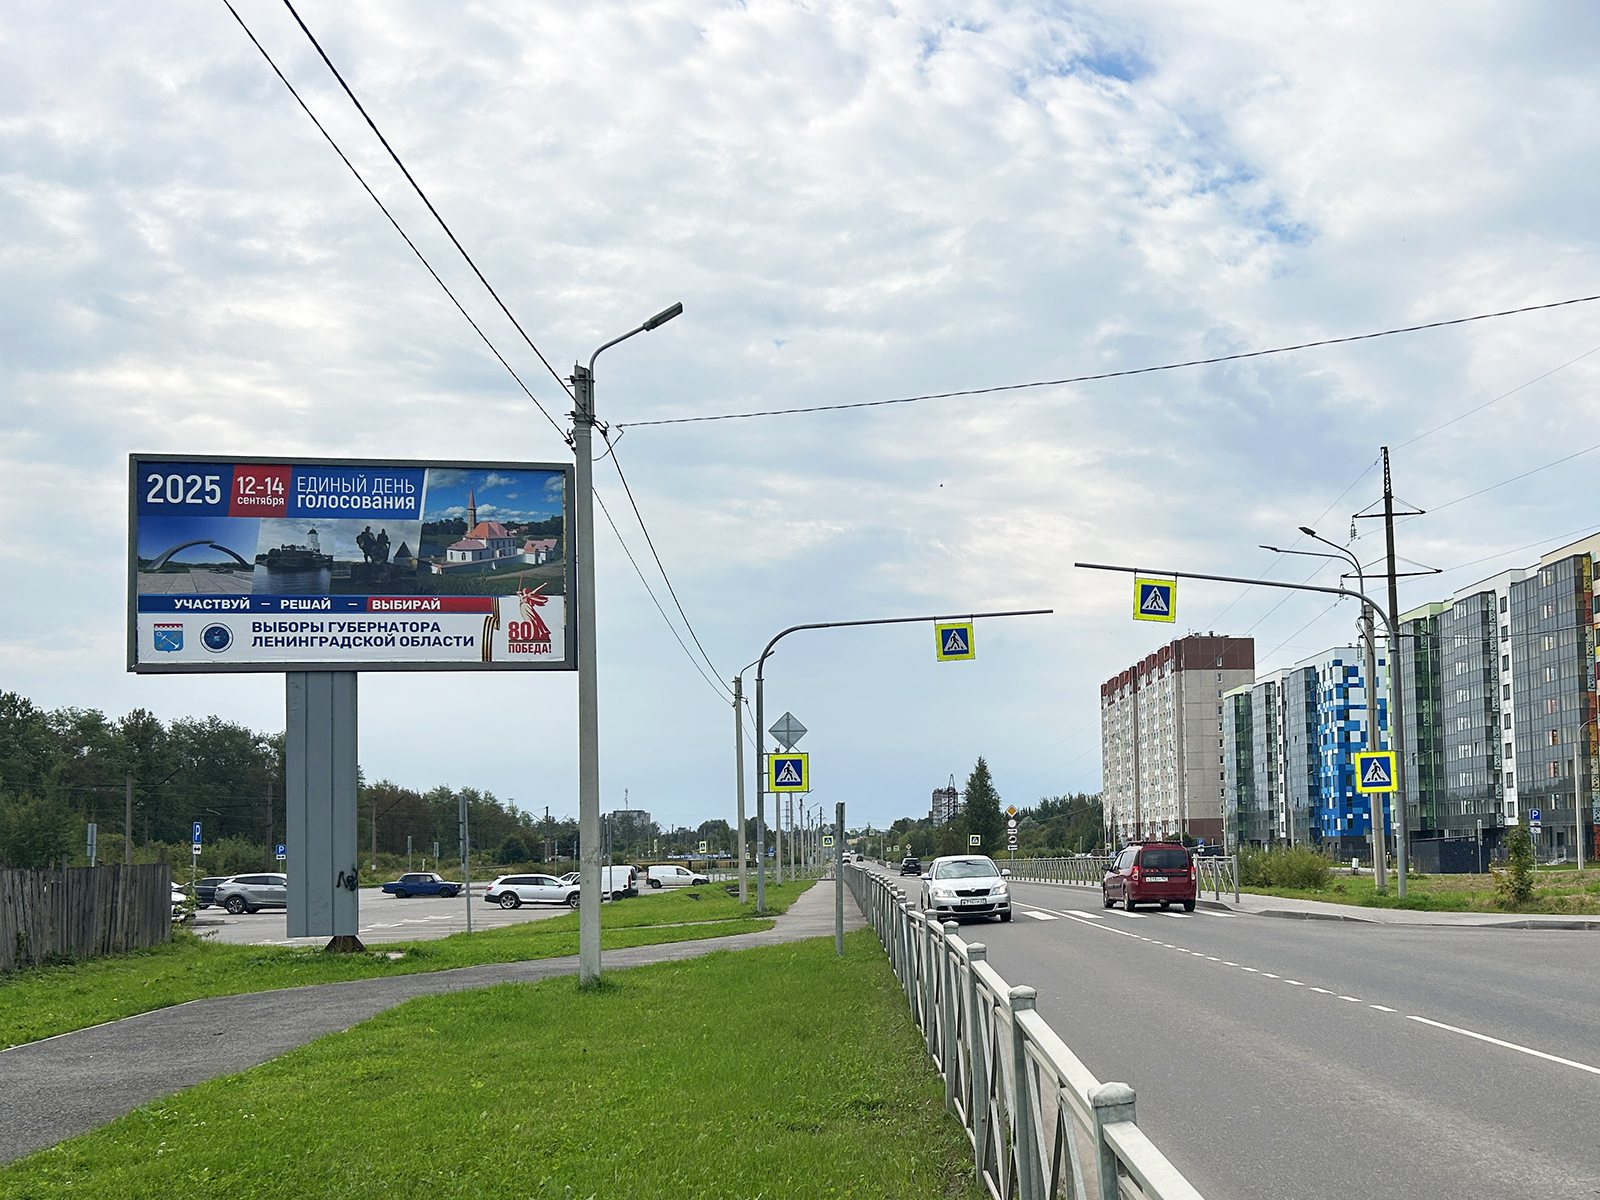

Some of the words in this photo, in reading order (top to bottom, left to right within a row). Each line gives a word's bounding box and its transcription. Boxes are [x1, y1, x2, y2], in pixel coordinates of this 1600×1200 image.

[146, 473, 221, 504] 2025
[237, 476, 285, 495] 12-14
[297, 474, 367, 494] ЕДИНЫЙ
[372, 478, 415, 495] ДЕНЬ
[237, 495, 285, 507] сентября
[297, 494, 415, 510] голосования
[174, 597, 250, 610] УЧАСТВУЙ
[280, 597, 331, 610] РЕШАЙ
[372, 597, 441, 610] ВЫБИРАЙ
[252, 621, 324, 633] ВЫБОРЫ
[328, 621, 441, 633] ГУБЕРНАТОРА
[508, 621, 532, 640] 80
[252, 633, 396, 649] ЛЕНИНГРАДСКОЙ
[399, 635, 474, 647] ОБЛАСТИ
[508, 643, 552, 655] ПОБЕДА!
